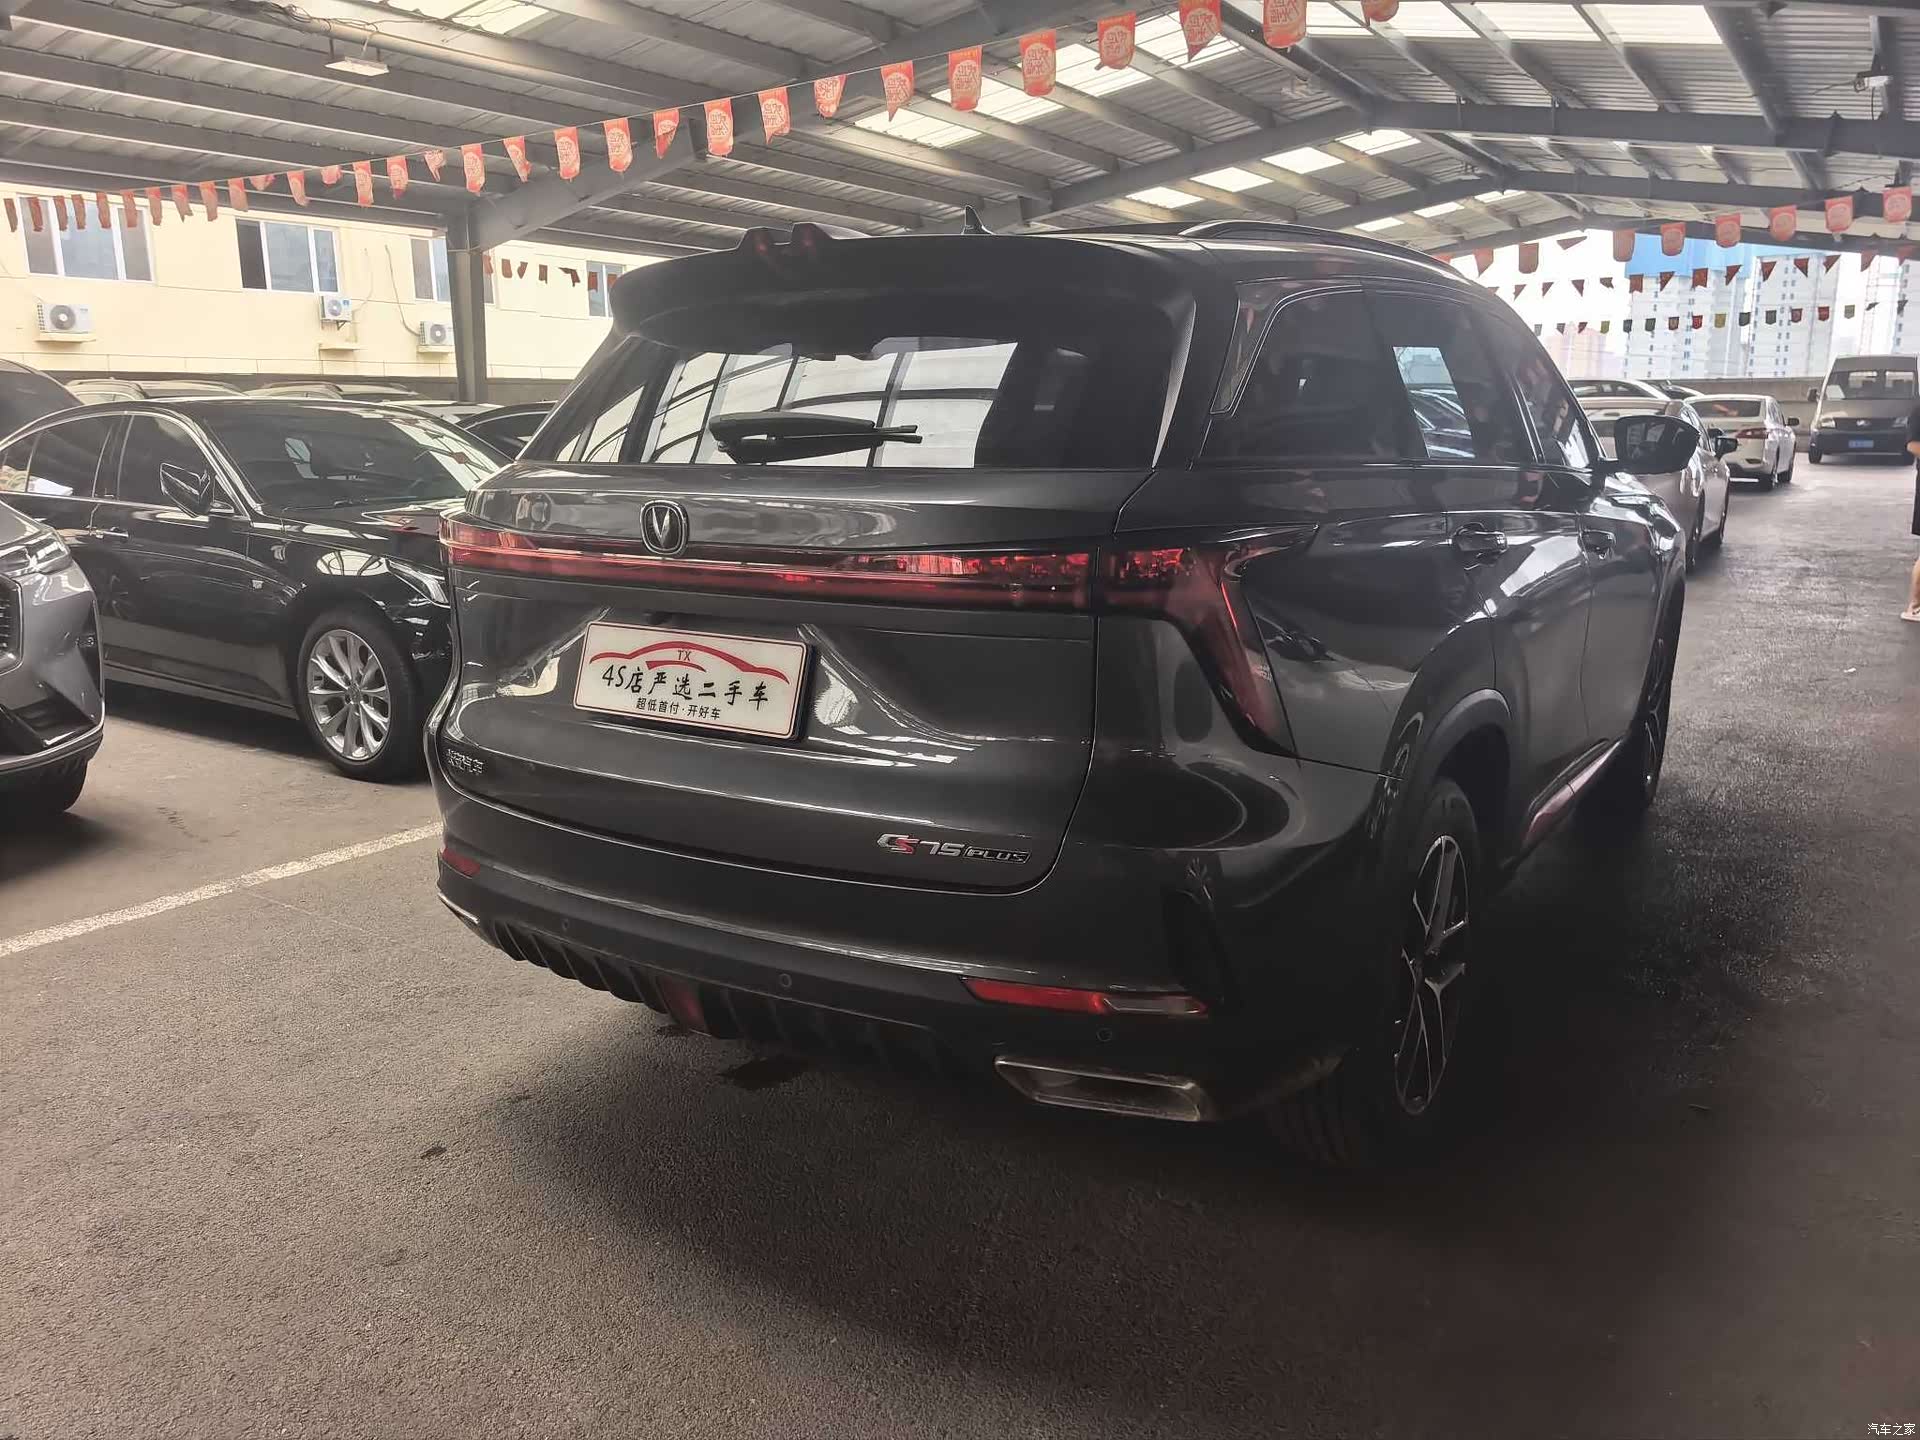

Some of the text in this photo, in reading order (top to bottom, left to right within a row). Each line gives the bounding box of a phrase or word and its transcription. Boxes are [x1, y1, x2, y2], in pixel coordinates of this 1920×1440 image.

[677, 650, 692, 662] TX
[602, 664, 769, 711] 4S店严选二手车
[965, 847, 1028, 862] PLUS
